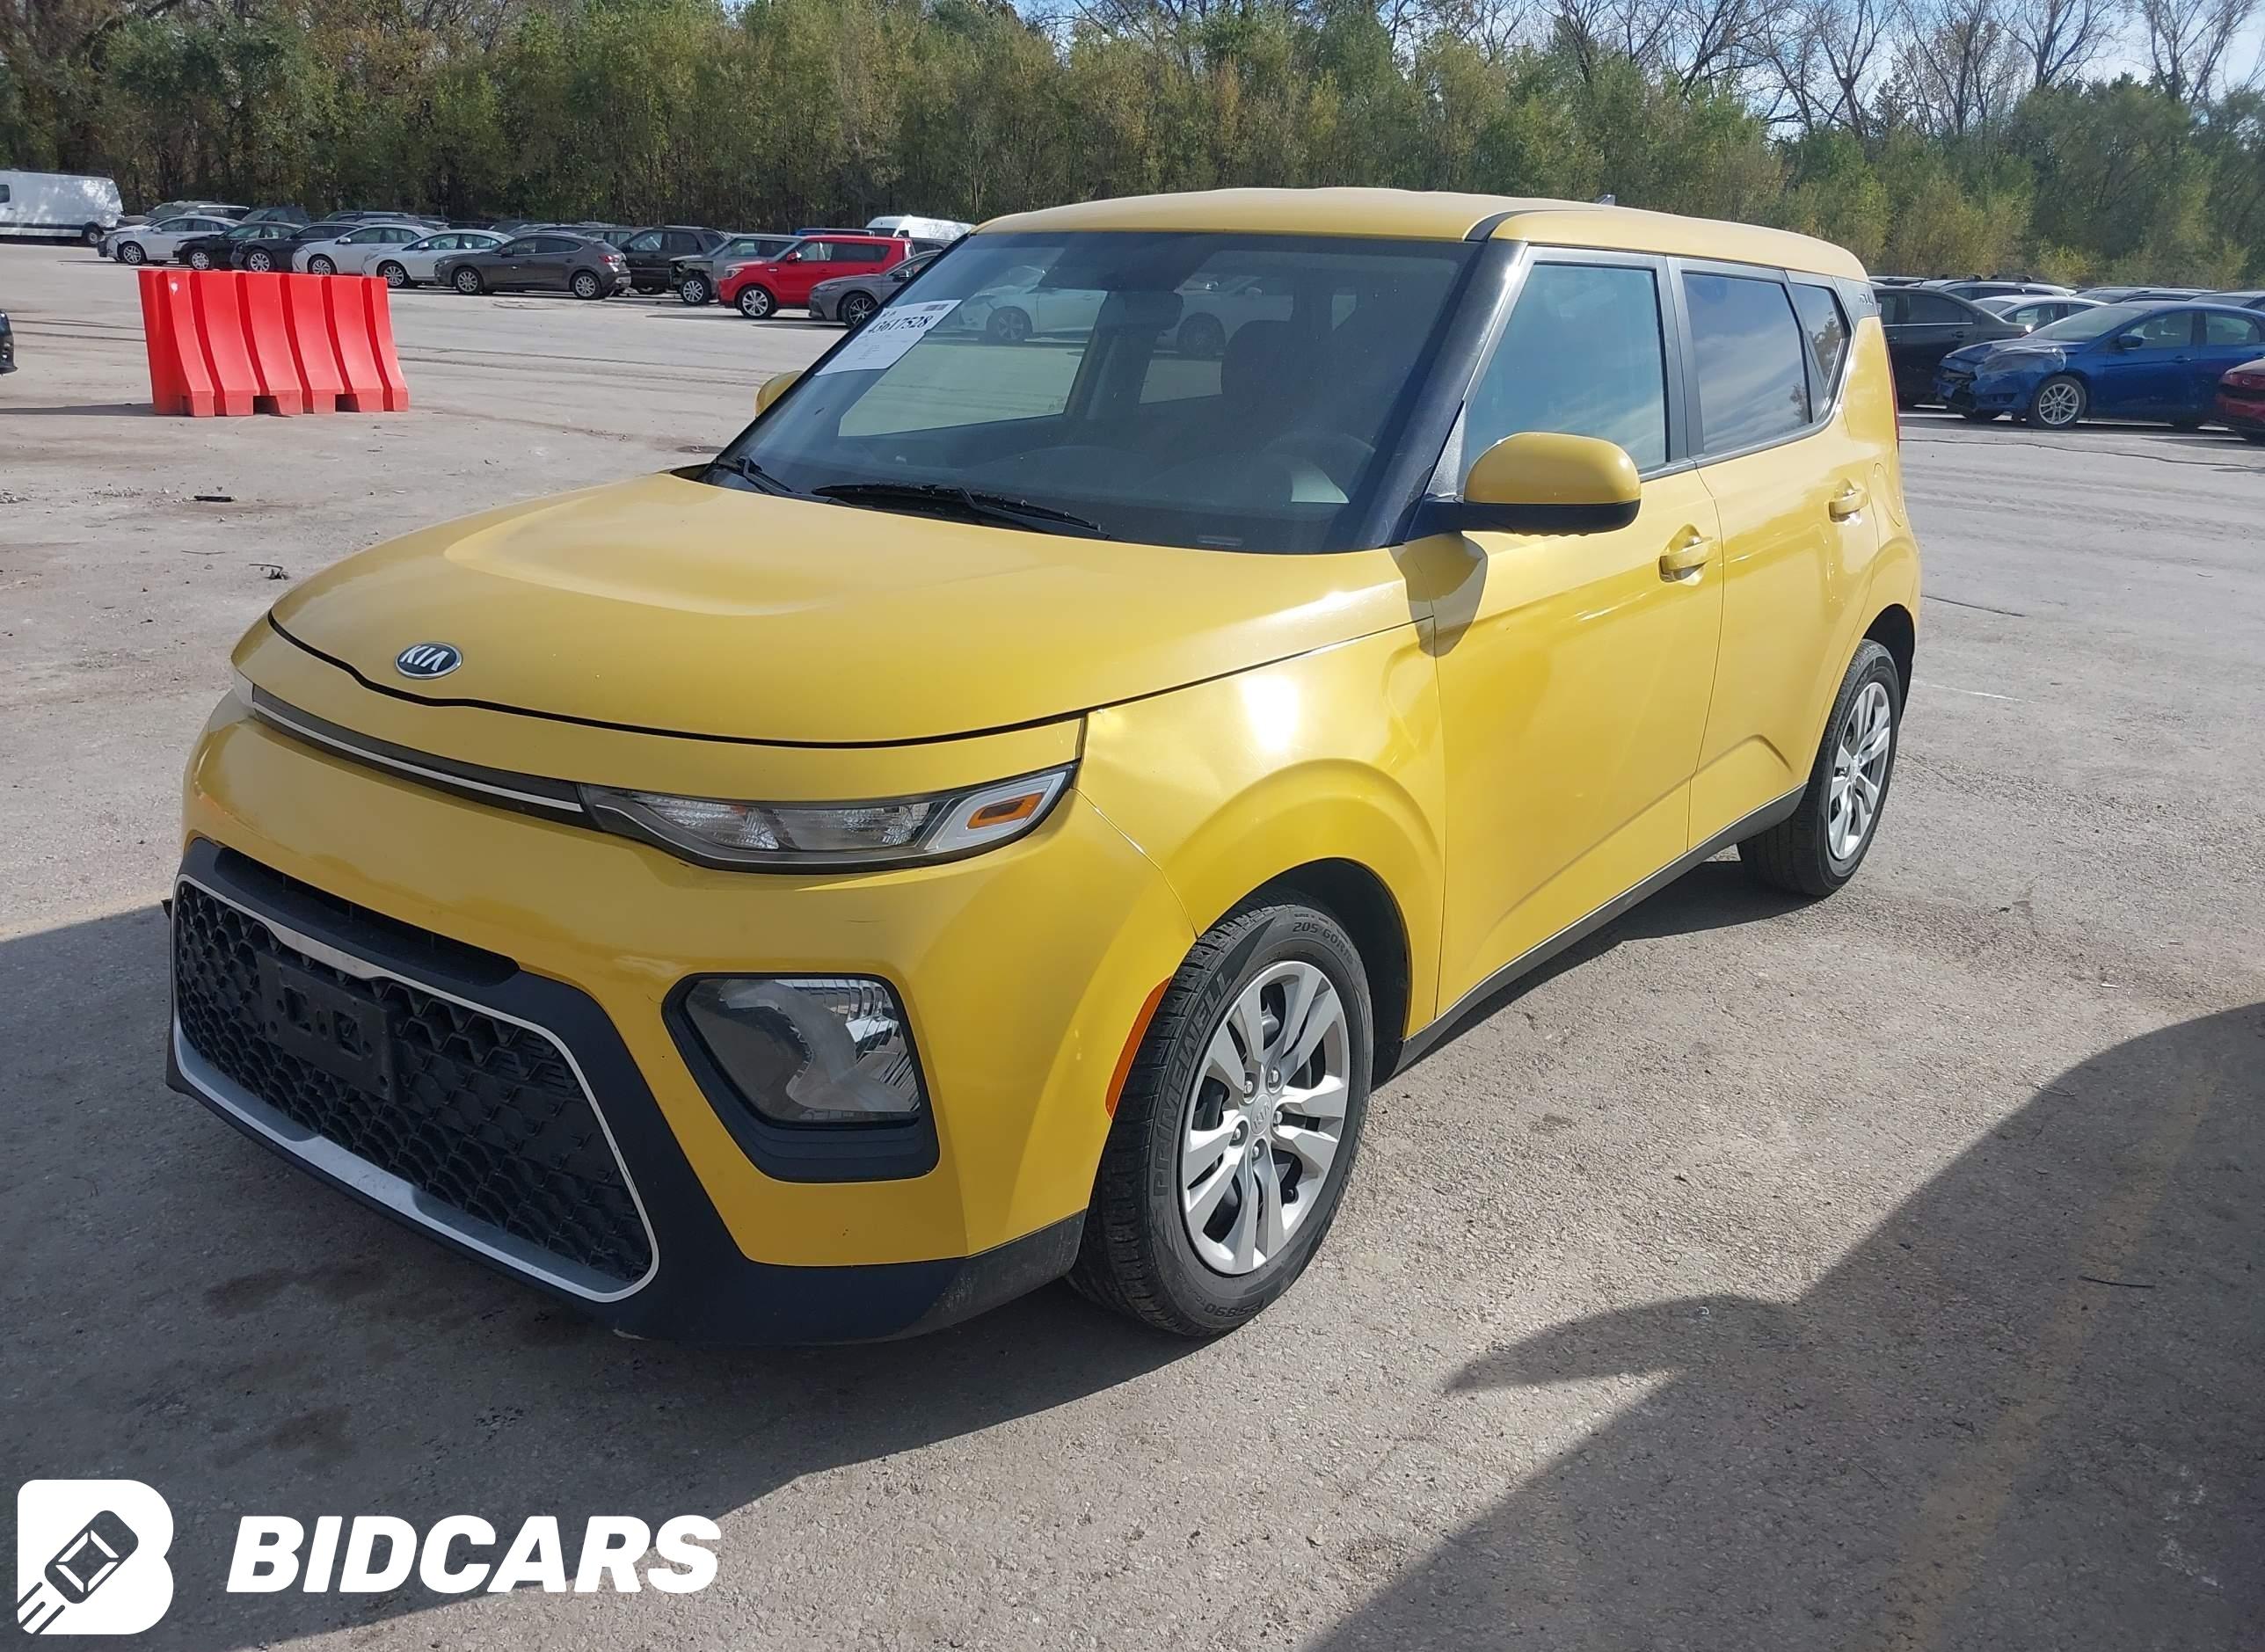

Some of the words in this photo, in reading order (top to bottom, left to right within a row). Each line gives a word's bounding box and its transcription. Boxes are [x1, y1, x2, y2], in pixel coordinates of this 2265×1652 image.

[399, 644, 450, 672] KIA
[1153, 971, 1233, 1197] PRIMEWELL
[1253, 1102, 1271, 1130] KIA
